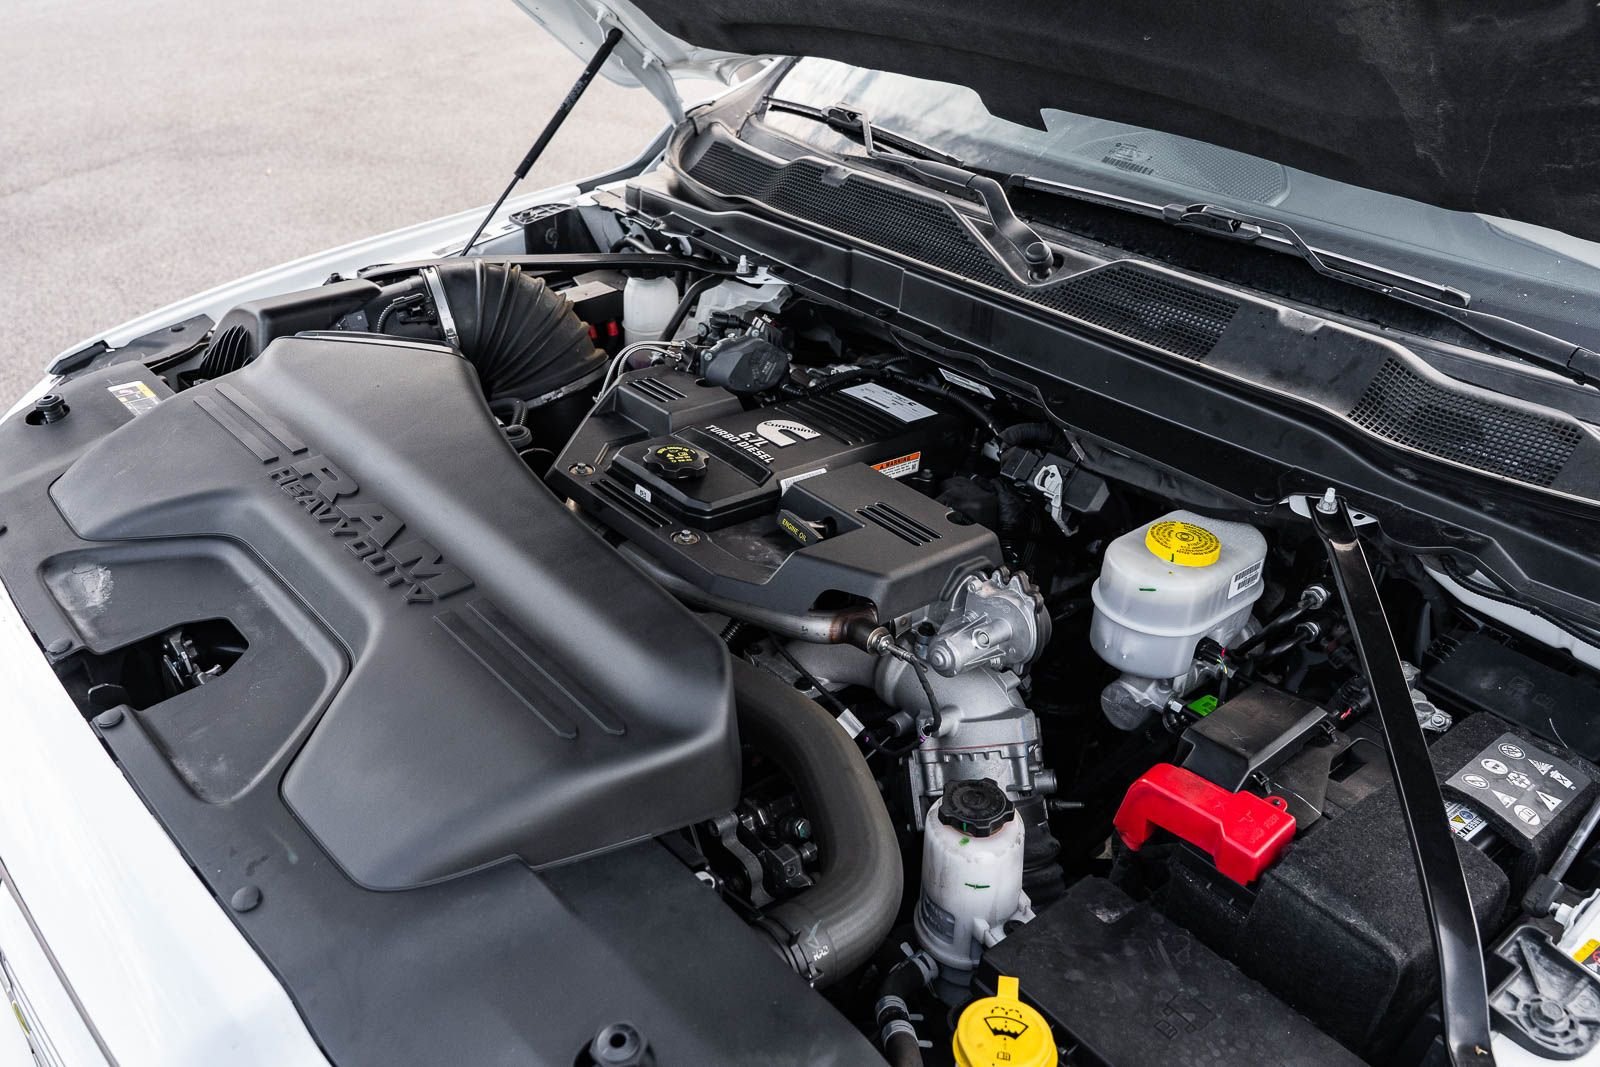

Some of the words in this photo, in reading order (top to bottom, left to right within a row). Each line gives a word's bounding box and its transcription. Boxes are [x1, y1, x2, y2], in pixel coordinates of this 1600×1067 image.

[705, 424, 741, 443] TURBO
[736, 442, 775, 464] DIESEL
[738, 431, 769, 448] 6.7L
[267, 465, 358, 537] HEAVY
[344, 534, 434, 604] DUTY
[289, 454, 475, 600] RAM
[782, 518, 800, 536] ENGINE
[799, 532, 807, 542] OIL
